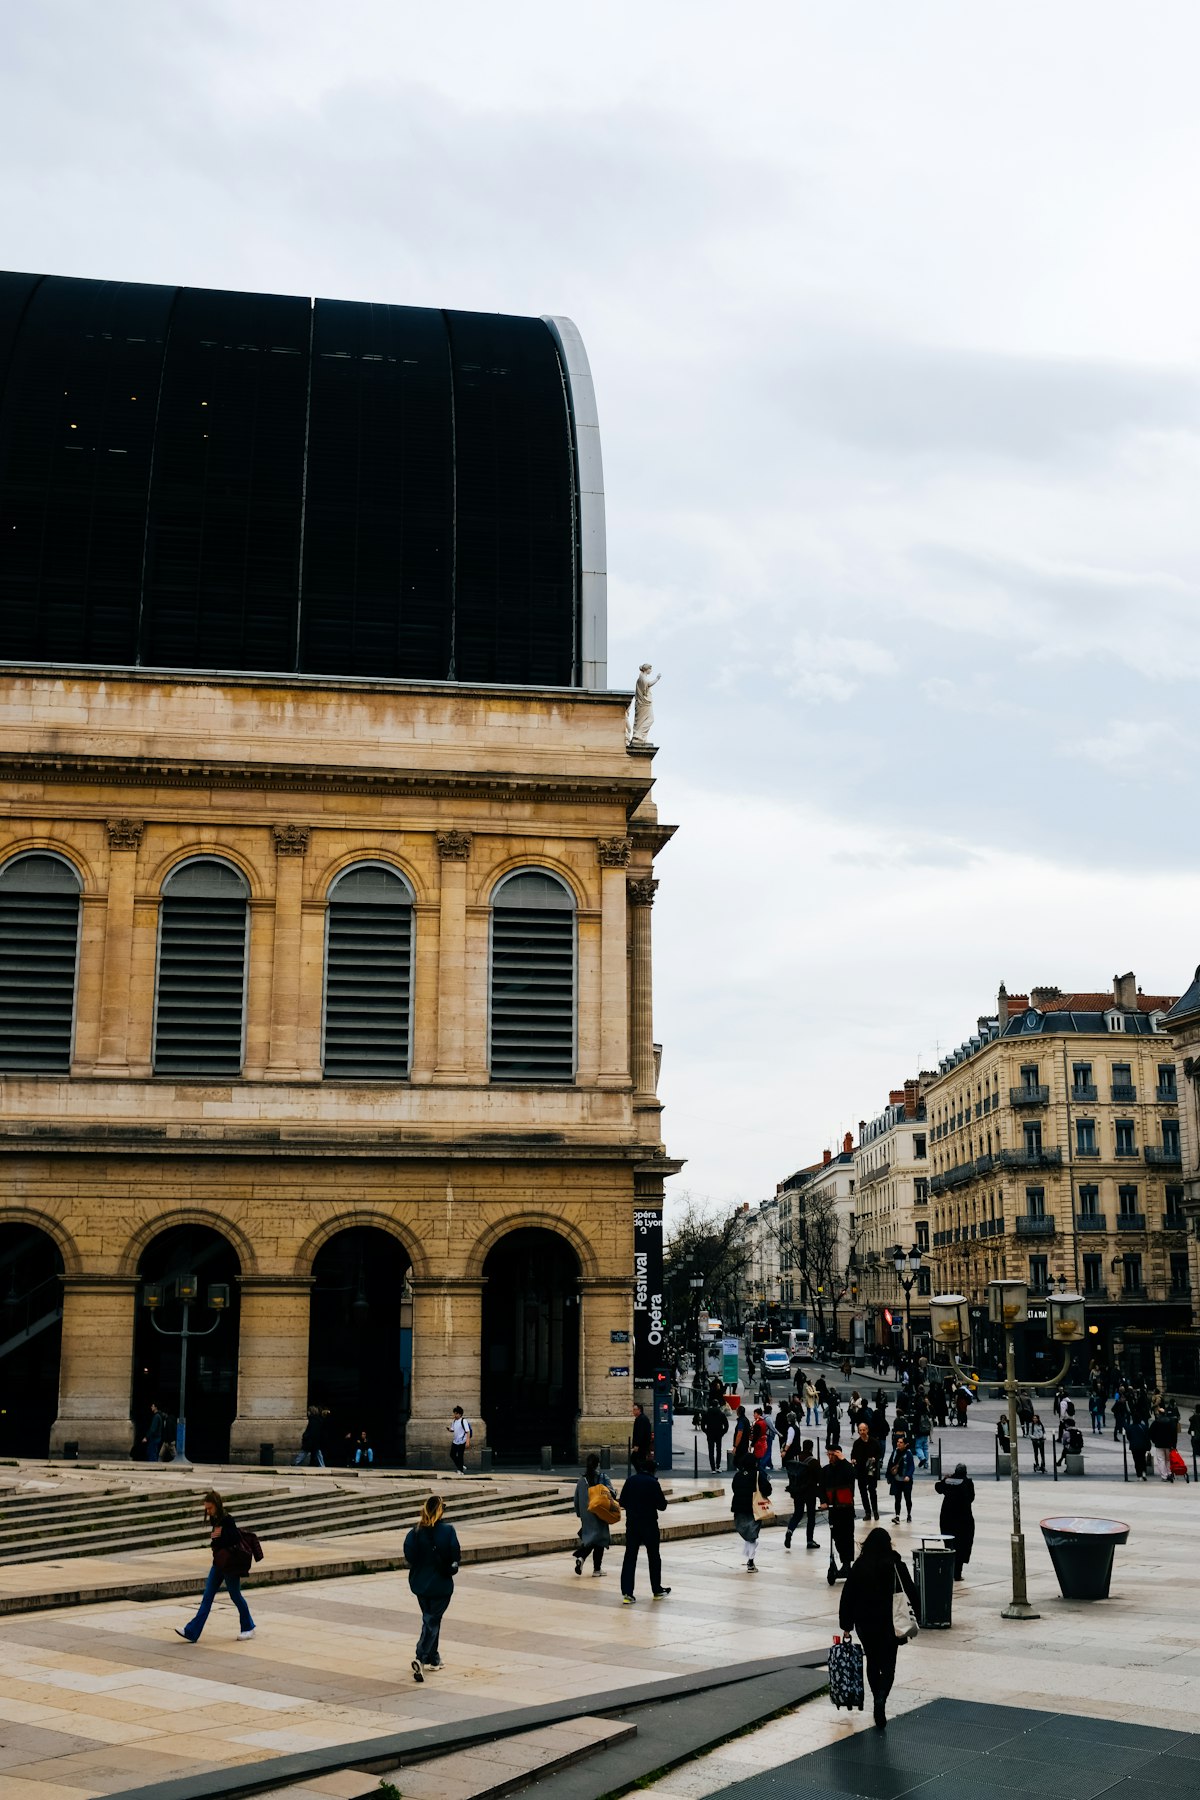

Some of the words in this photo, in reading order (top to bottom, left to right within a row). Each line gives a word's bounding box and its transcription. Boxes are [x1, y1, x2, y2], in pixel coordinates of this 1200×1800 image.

[633, 1211, 657, 1219] opéra
[644, 1219, 663, 1228] Lyon
[634, 1252, 647, 1310] Festival
[648, 1294, 664, 1345] Opéra
